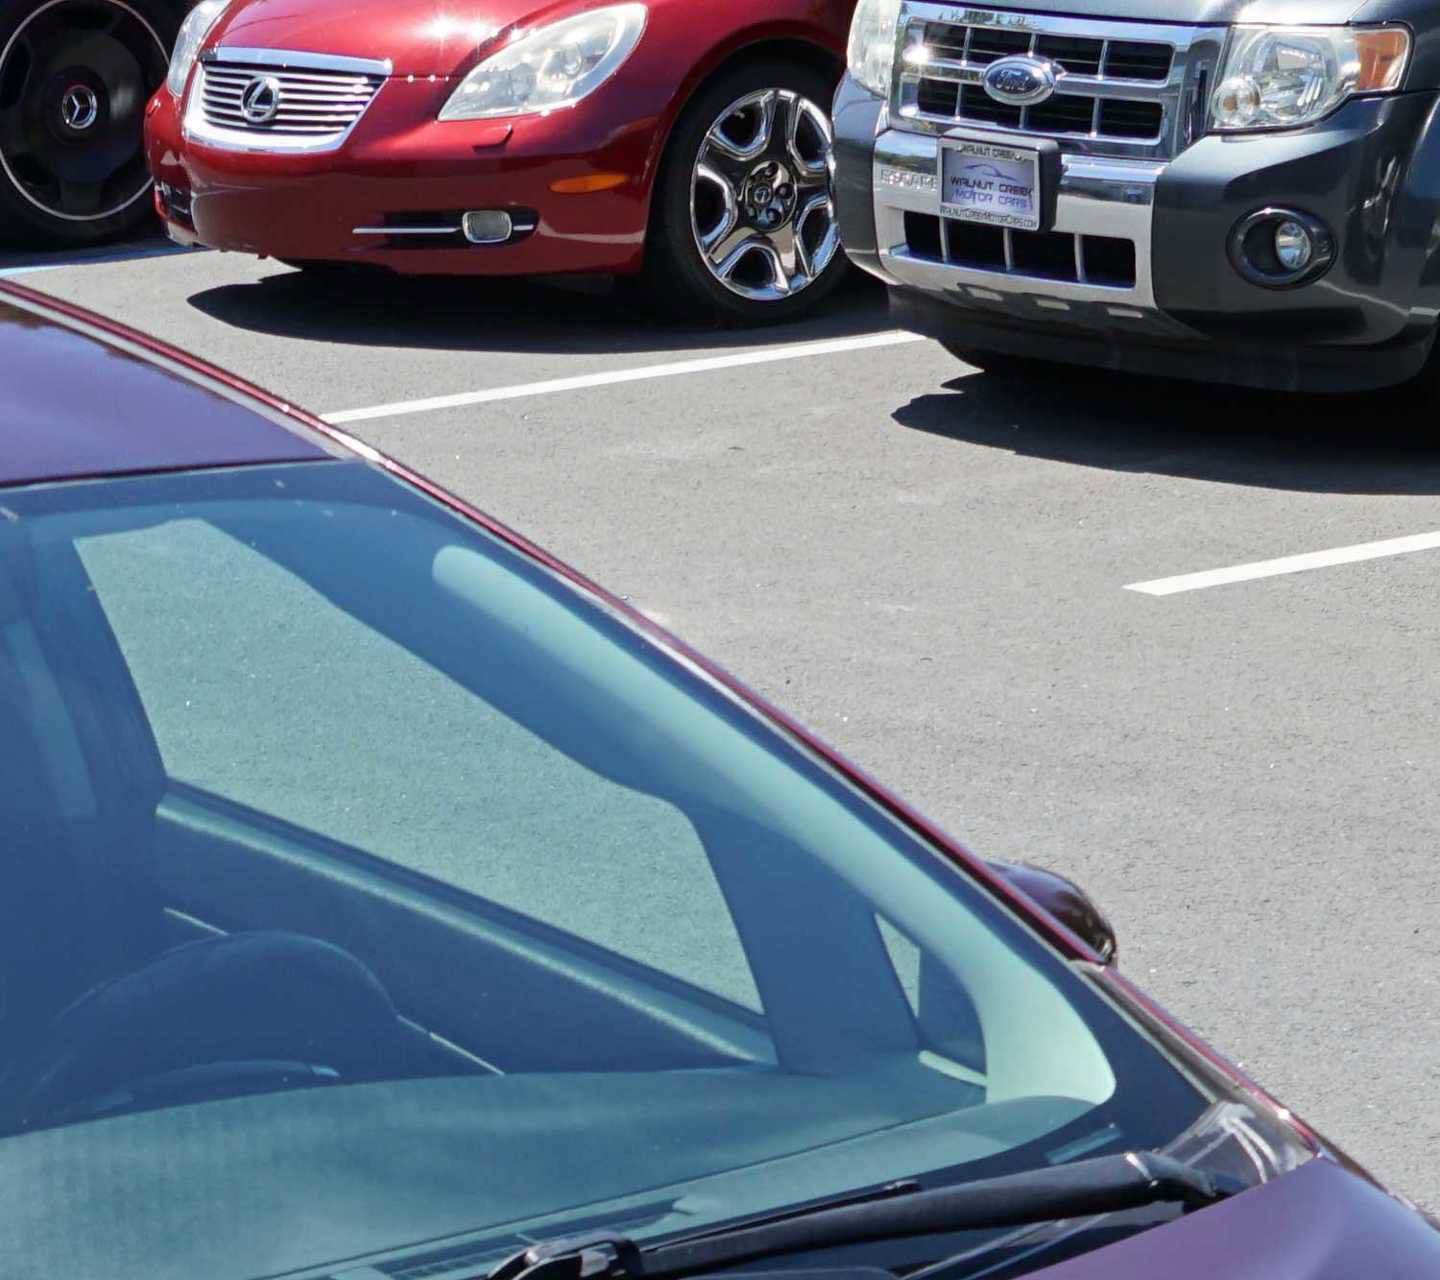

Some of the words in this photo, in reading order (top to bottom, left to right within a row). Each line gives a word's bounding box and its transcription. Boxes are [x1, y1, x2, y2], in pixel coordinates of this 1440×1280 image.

[950, 175, 992, 190] WALNUT
[998, 183, 1034, 197] CREEK
[954, 188, 993, 203] MOTOR
[998, 195, 1029, 209] CARS
